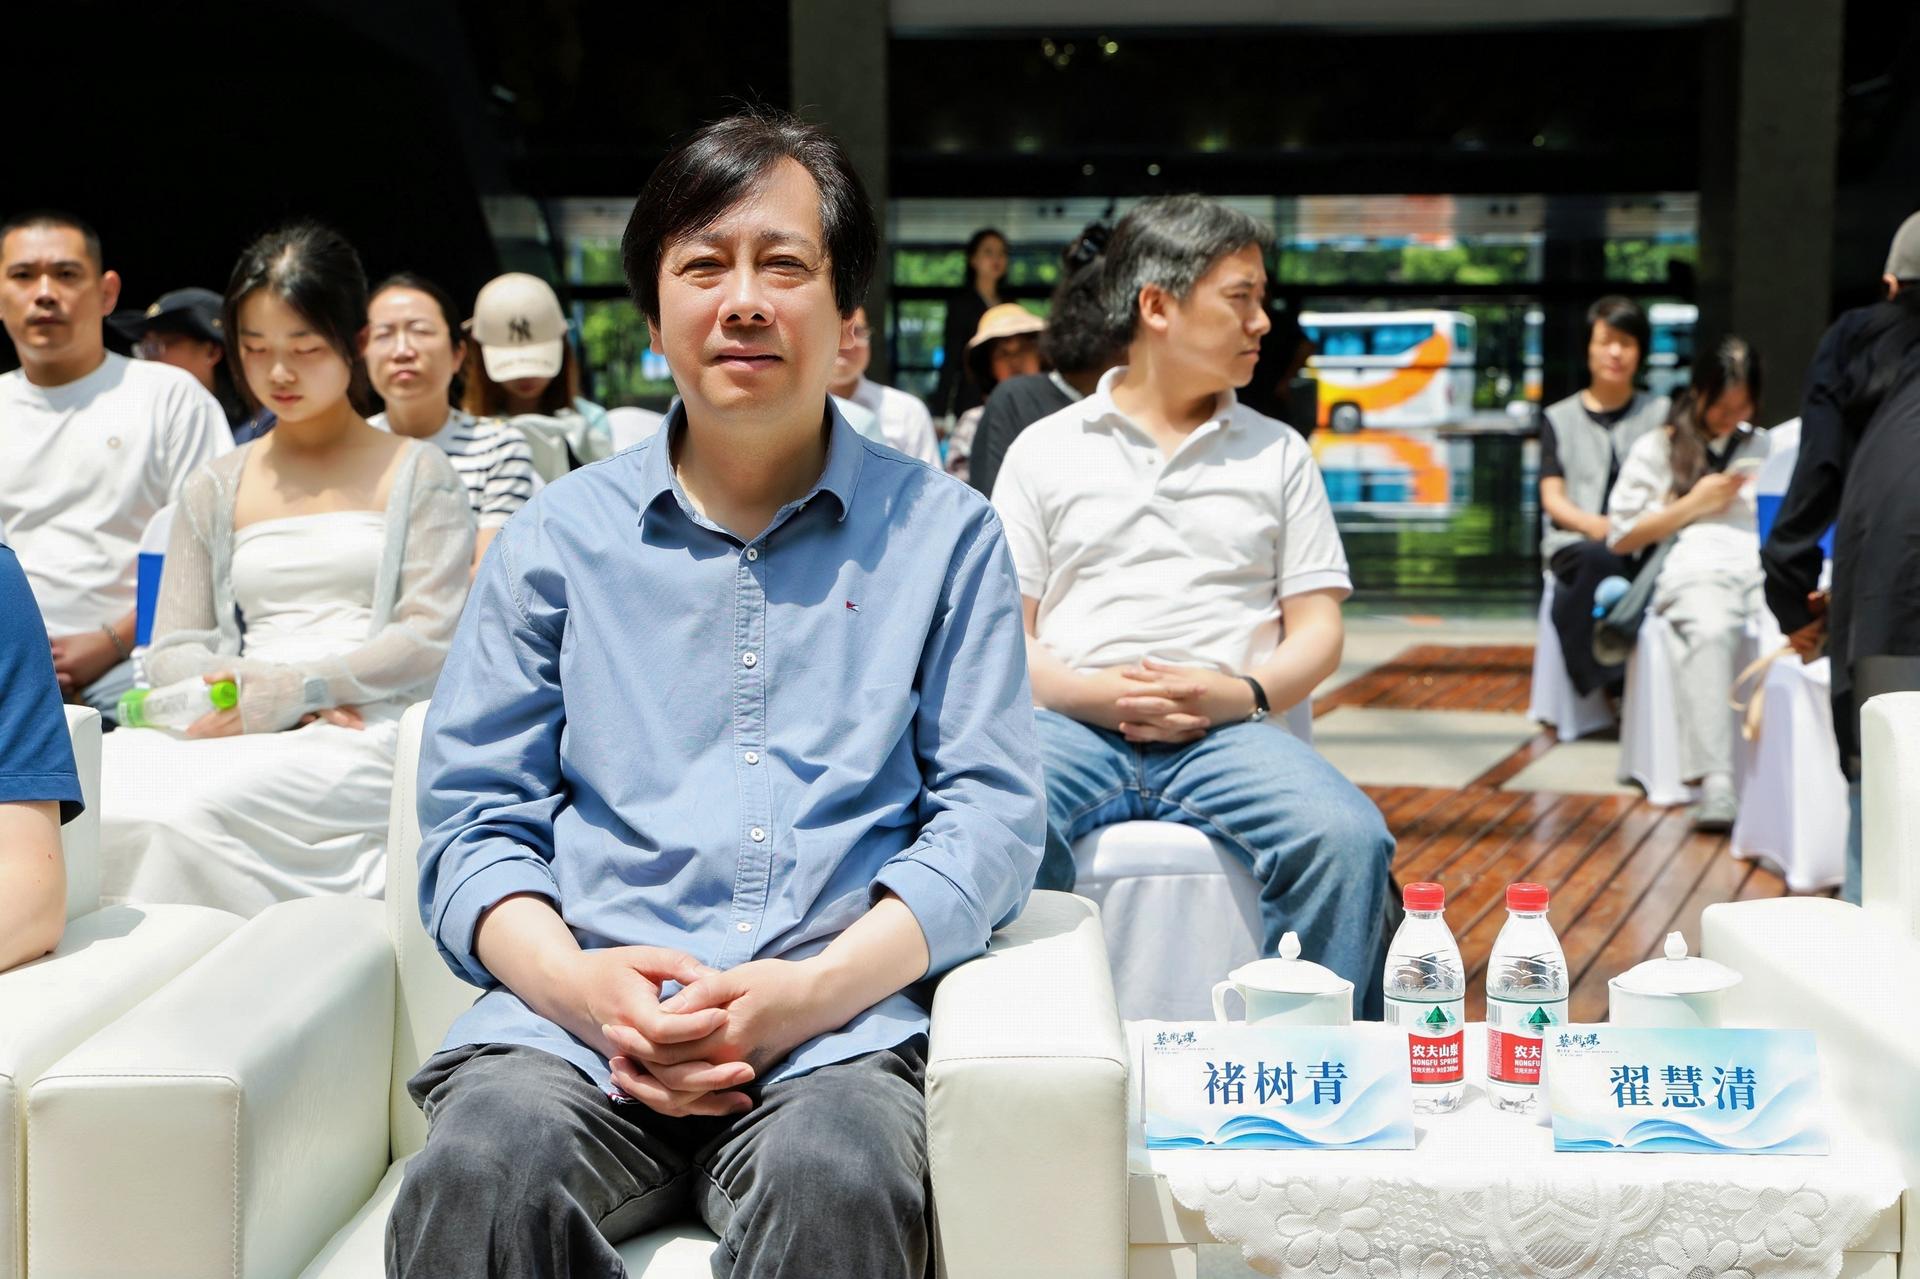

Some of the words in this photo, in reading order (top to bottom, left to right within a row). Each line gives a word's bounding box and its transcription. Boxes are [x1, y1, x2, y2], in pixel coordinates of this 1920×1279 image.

[508, 315, 531, 342] NY
[1412, 1042, 1458, 1058] 农夫山泉
[1412, 1058, 1438, 1066] NONGFU
[1203, 1061, 1348, 1105] 褚树青
[1610, 1065, 1757, 1110] 翟慧清
